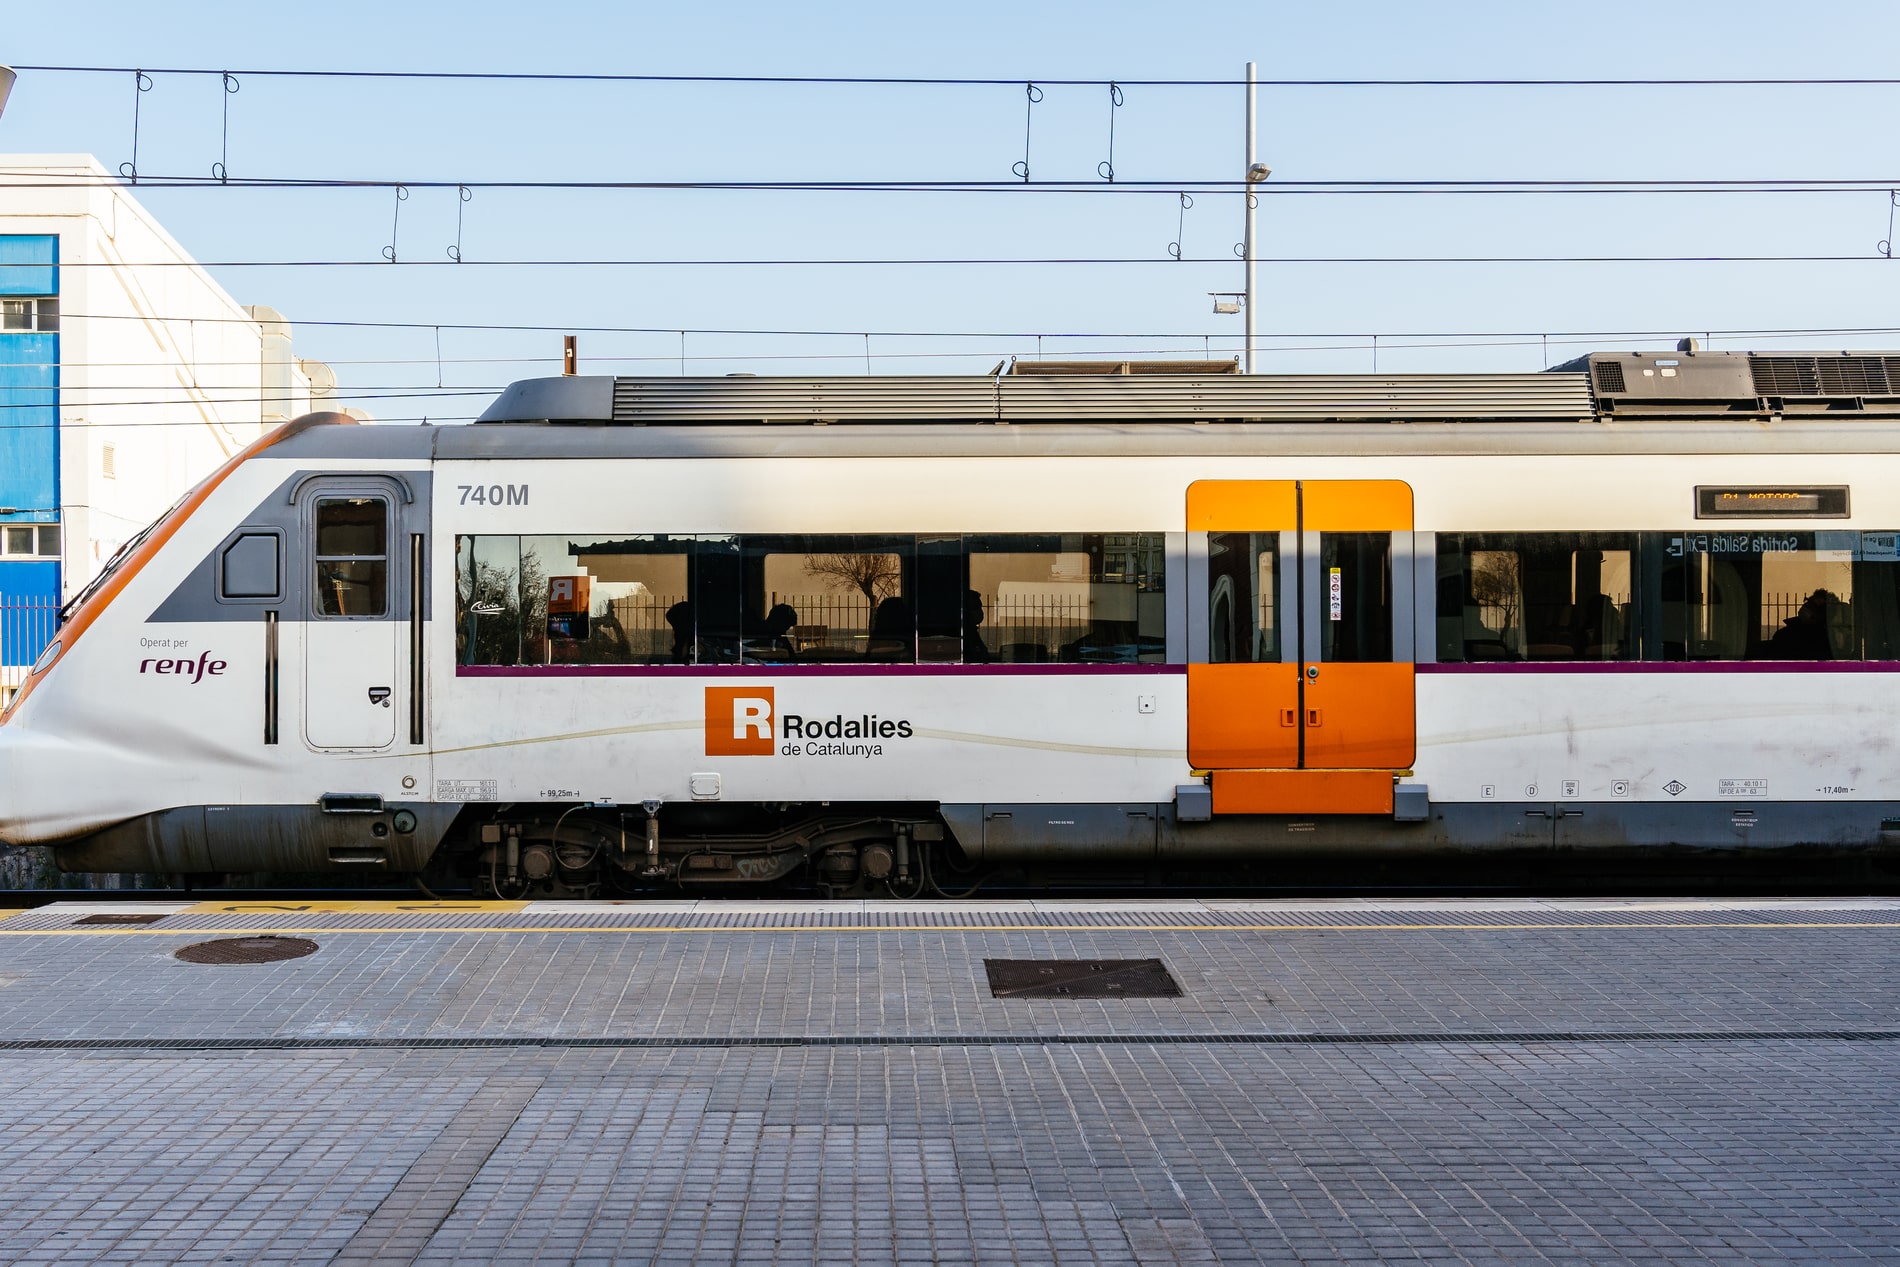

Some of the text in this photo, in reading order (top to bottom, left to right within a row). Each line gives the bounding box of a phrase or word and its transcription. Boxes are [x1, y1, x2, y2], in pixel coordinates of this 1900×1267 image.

[457, 484, 529, 506] 740M
[471, 601, 503, 613] Civia
[140, 637, 189, 649] Operat per
[139, 650, 227, 684] renfe
[733, 697, 772, 740] R
[783, 714, 913, 739] Rodalies
[781, 742, 883, 758] de Catalunya
[547, 789, 573, 798] 99,25m
[1485, 787, 1491, 795] E
[1529, 787, 1535, 795] D
[1823, 786, 1849, 794] 17,40m
